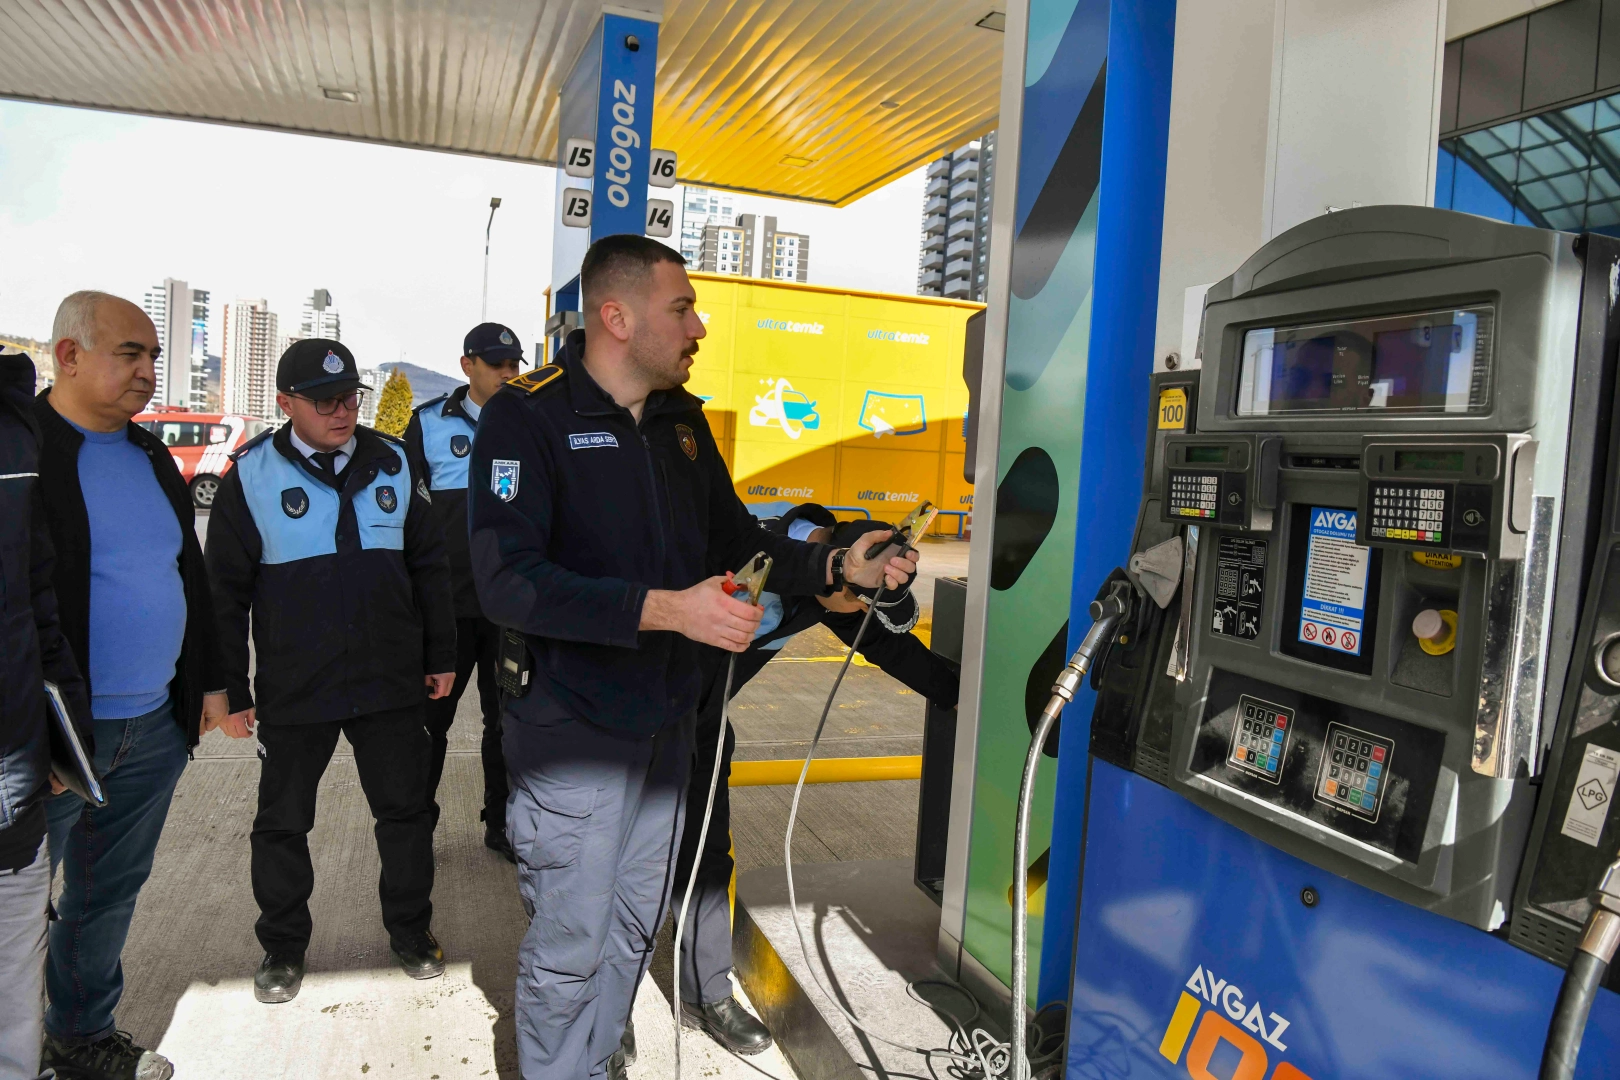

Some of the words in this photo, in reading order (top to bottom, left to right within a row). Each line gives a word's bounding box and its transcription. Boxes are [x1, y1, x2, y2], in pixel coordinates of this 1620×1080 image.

[605, 79, 641, 208] otogaz
[568, 147, 592, 167] 15
[652, 158, 675, 177] 16
[567, 197, 589, 217] 13
[648, 208, 671, 228] 14
[757, 318, 824, 335] ultratemiz
[867, 329, 930, 345] ultratemiz
[1162, 405, 1183, 422] 100
[748, 485, 814, 498] ultratemiz
[857, 490, 919, 502] ultratemiz
[1425, 560, 1453, 568] ATTENTION
[1581, 787, 1603, 802] LPG
[1185, 964, 1290, 1052] AYGAZ
[1159, 990, 1314, 1080] 10
